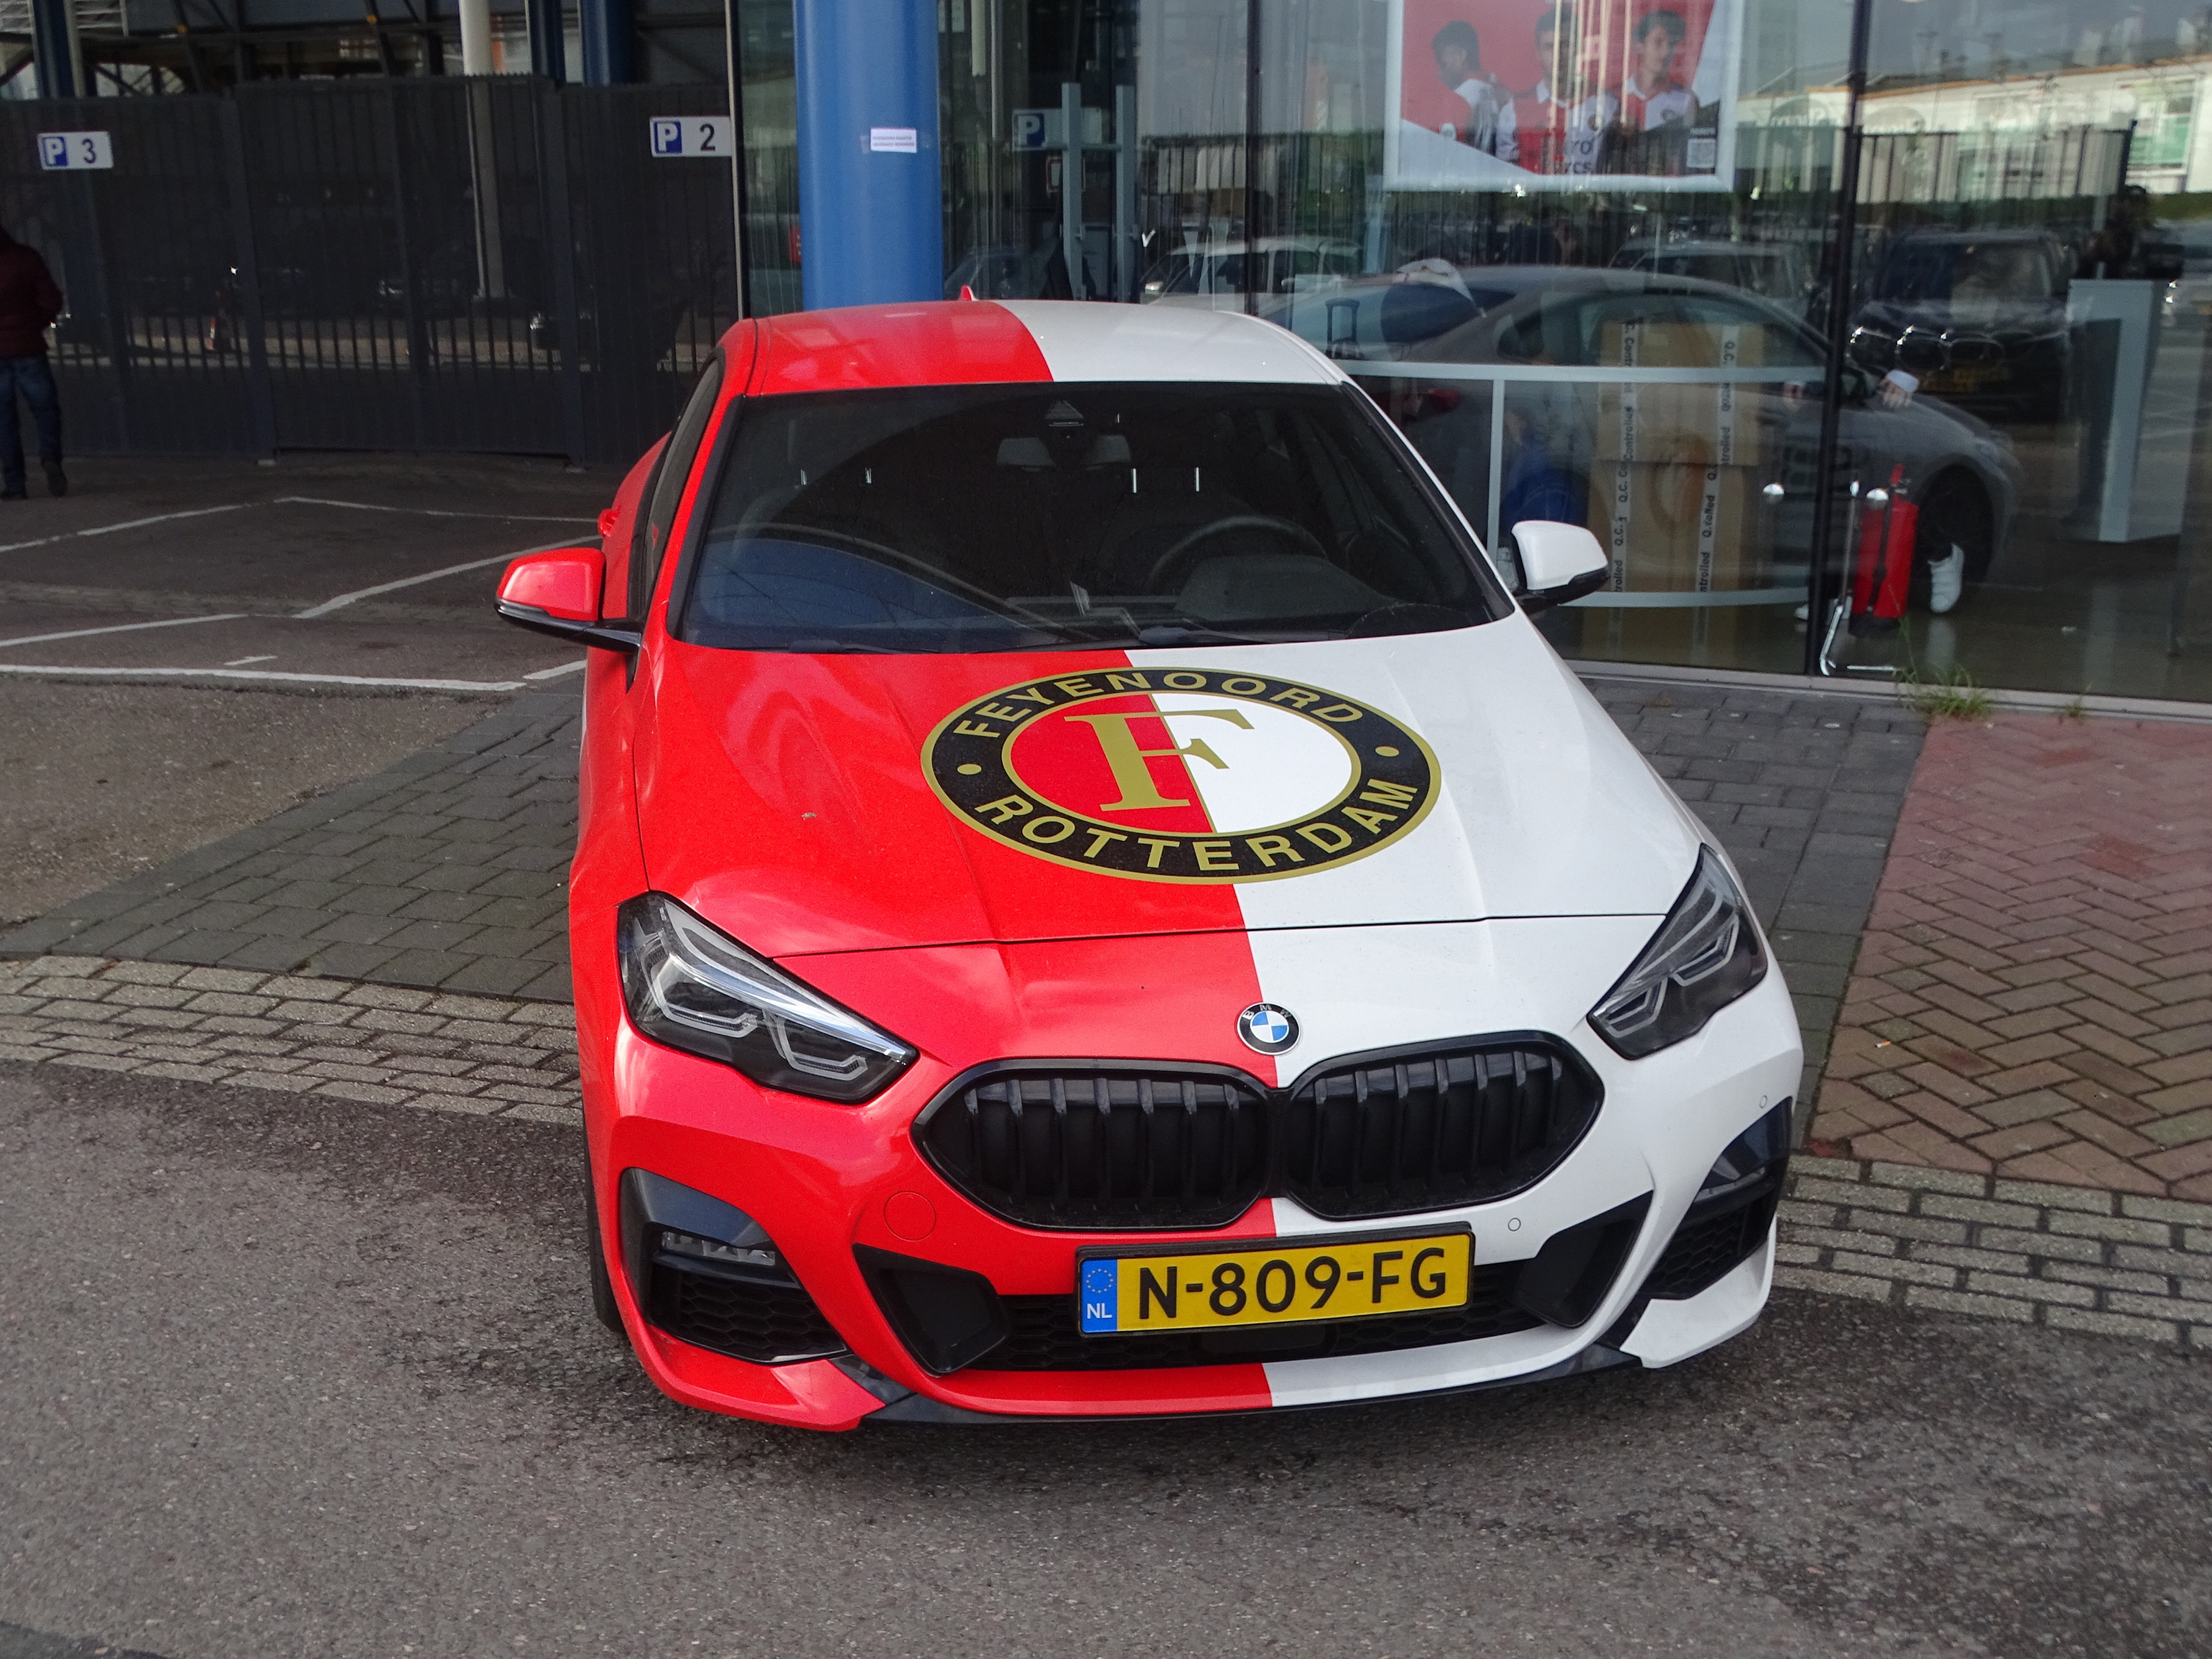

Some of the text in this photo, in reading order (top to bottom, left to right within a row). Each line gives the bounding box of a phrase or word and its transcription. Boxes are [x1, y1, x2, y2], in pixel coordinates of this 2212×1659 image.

[657, 123, 715, 151] P 2
[1018, 115, 1040, 146] P
[46, 138, 96, 165] P 3
[953, 672, 1363, 738] FEYENOORD
[1063, 709, 1255, 811] F
[975, 778, 1418, 872] ROTTERDAM
[1243, 1004, 1292, 1020] BMW
[1138, 1247, 1446, 1320] N-809-FG
[1086, 1302, 1113, 1319] NL
